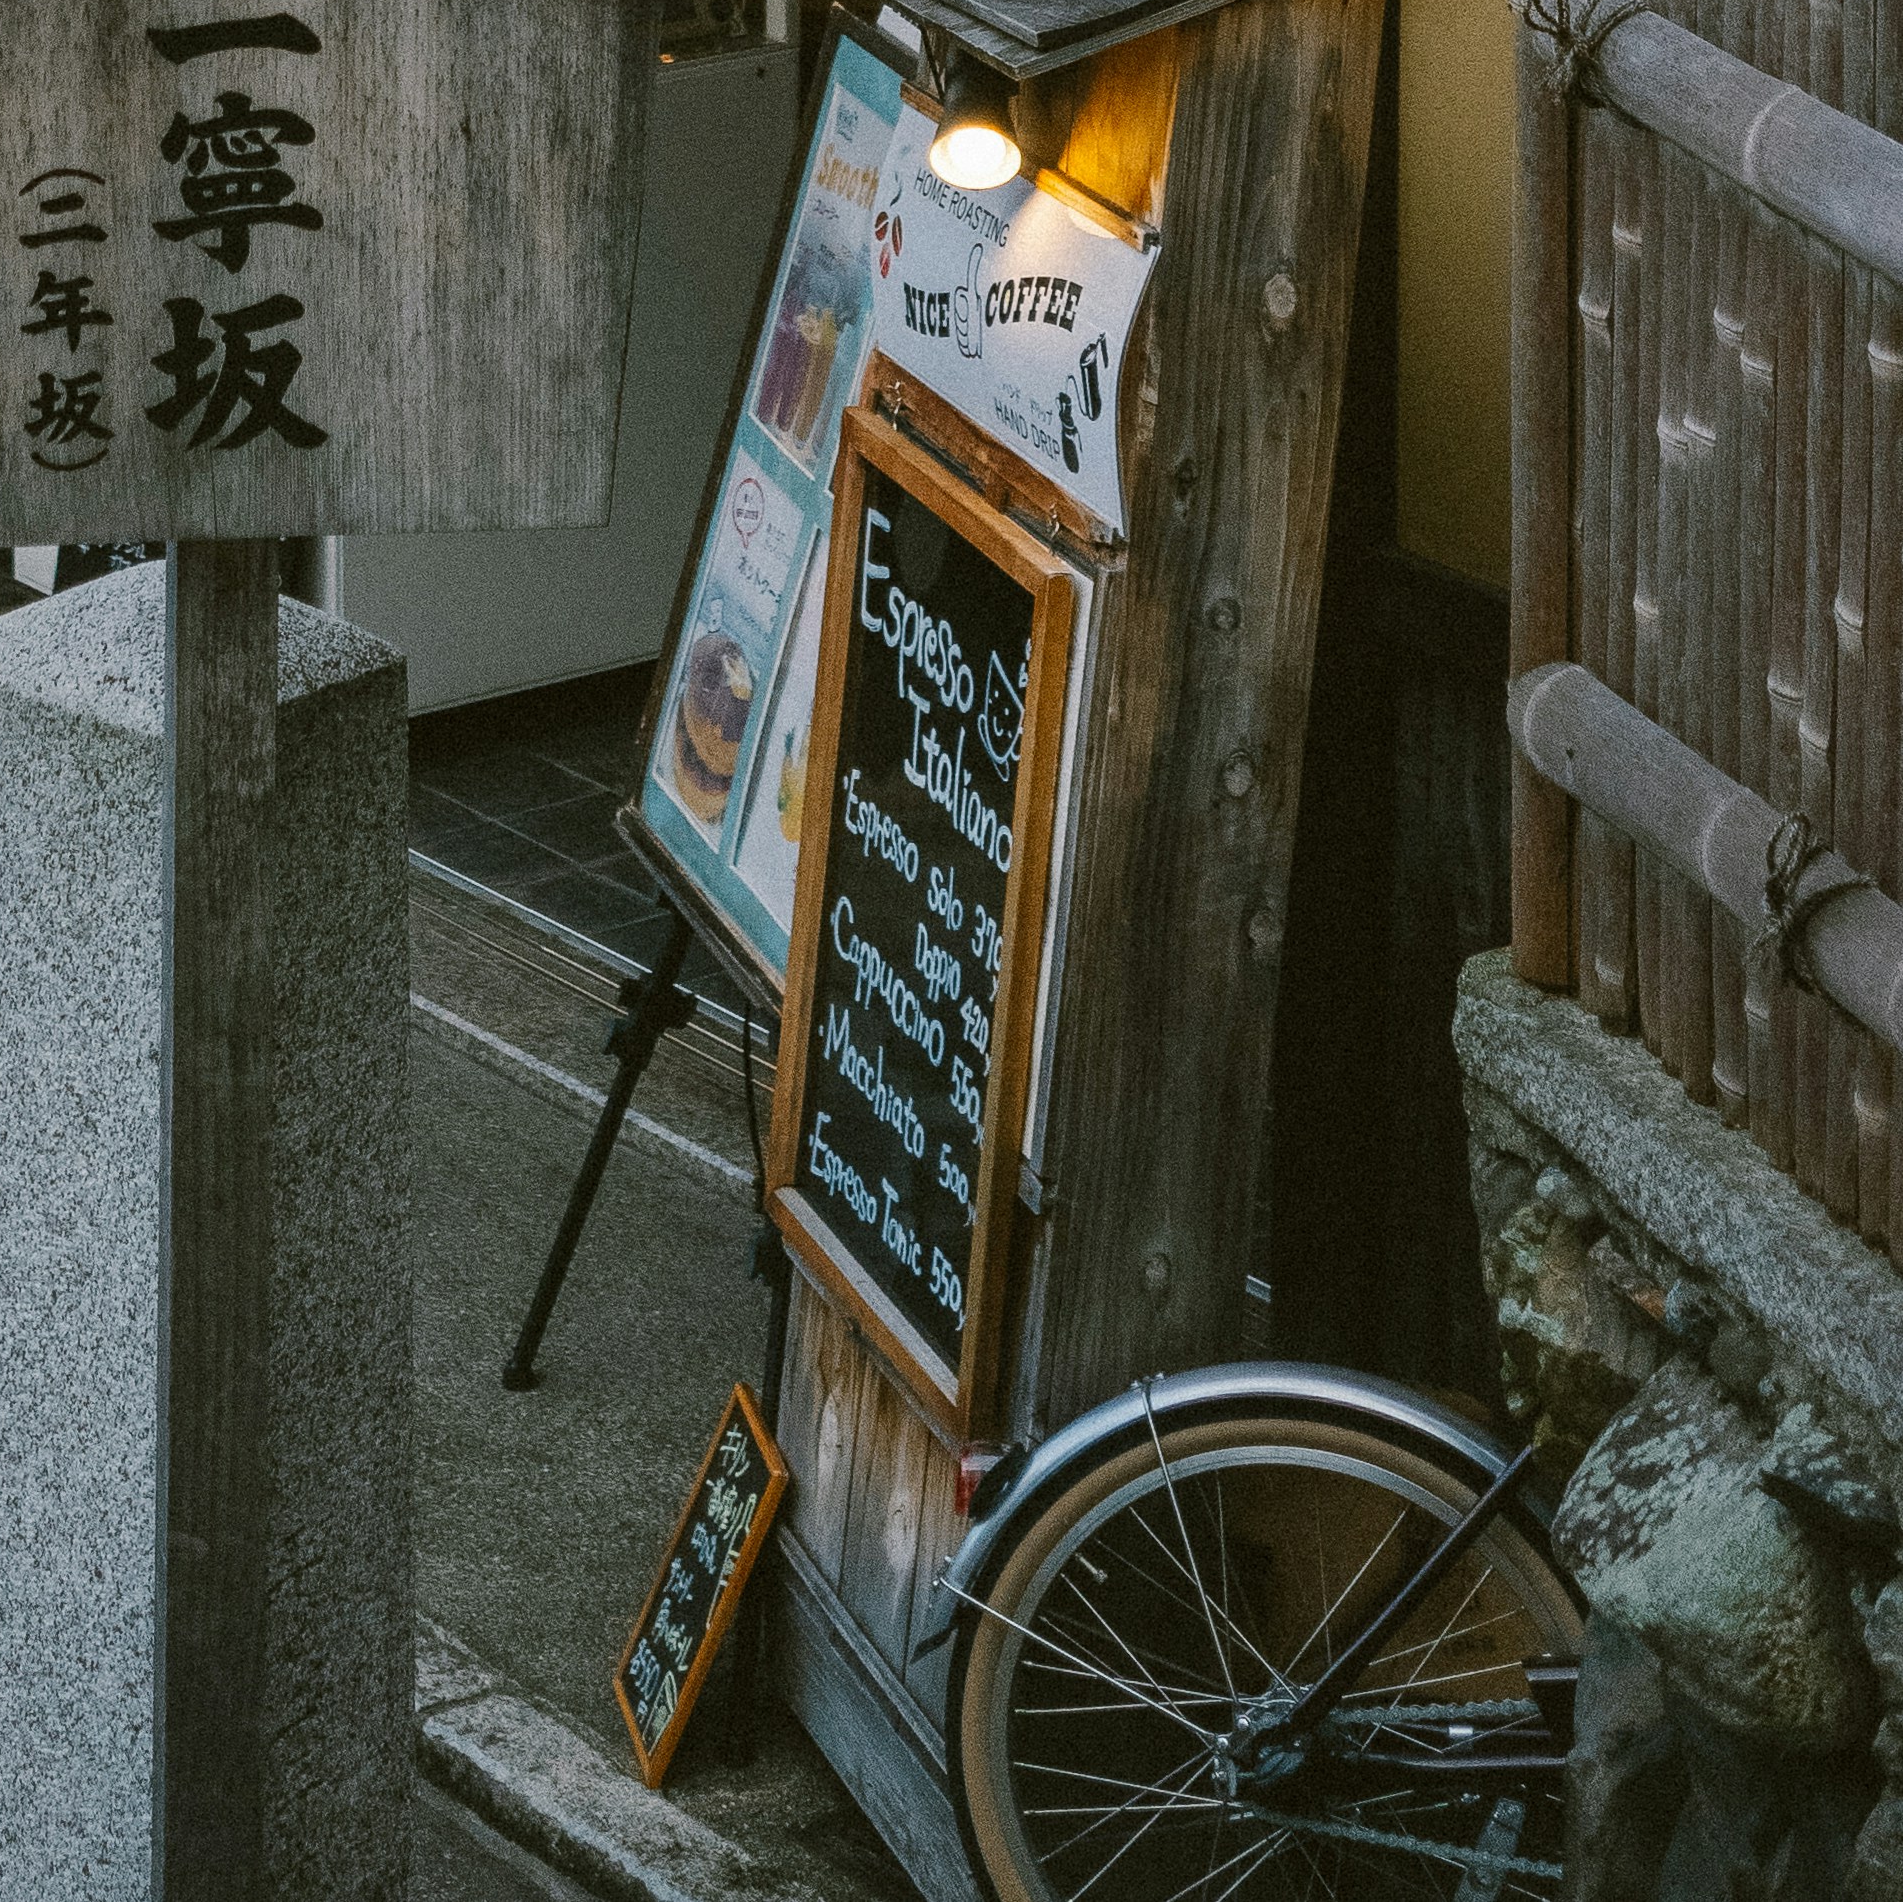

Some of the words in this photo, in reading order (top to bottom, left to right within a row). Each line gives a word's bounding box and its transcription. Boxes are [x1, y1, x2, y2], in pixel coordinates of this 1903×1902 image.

[913, 167, 951, 209] HOME
[948, 190, 1010, 248] ROASTING
[903, 281, 951, 338] NICE
[985, 276, 1084, 333] COFFEE
[994, 397, 1029, 440] HAND
[1030, 423, 1061, 462] DRIP
[861, 507, 974, 713] Espresso
[844, 768, 919, 883] Espresso
[904, 685, 1013, 873] Italiano
[833, 896, 945, 1068] Cappuccino
[914, 922, 961, 1003] Doppio
[824, 1003, 925, 1159] Macchiato
[810, 1111, 878, 1225] Espresso
[882, 1177, 923, 1277] Tonic
